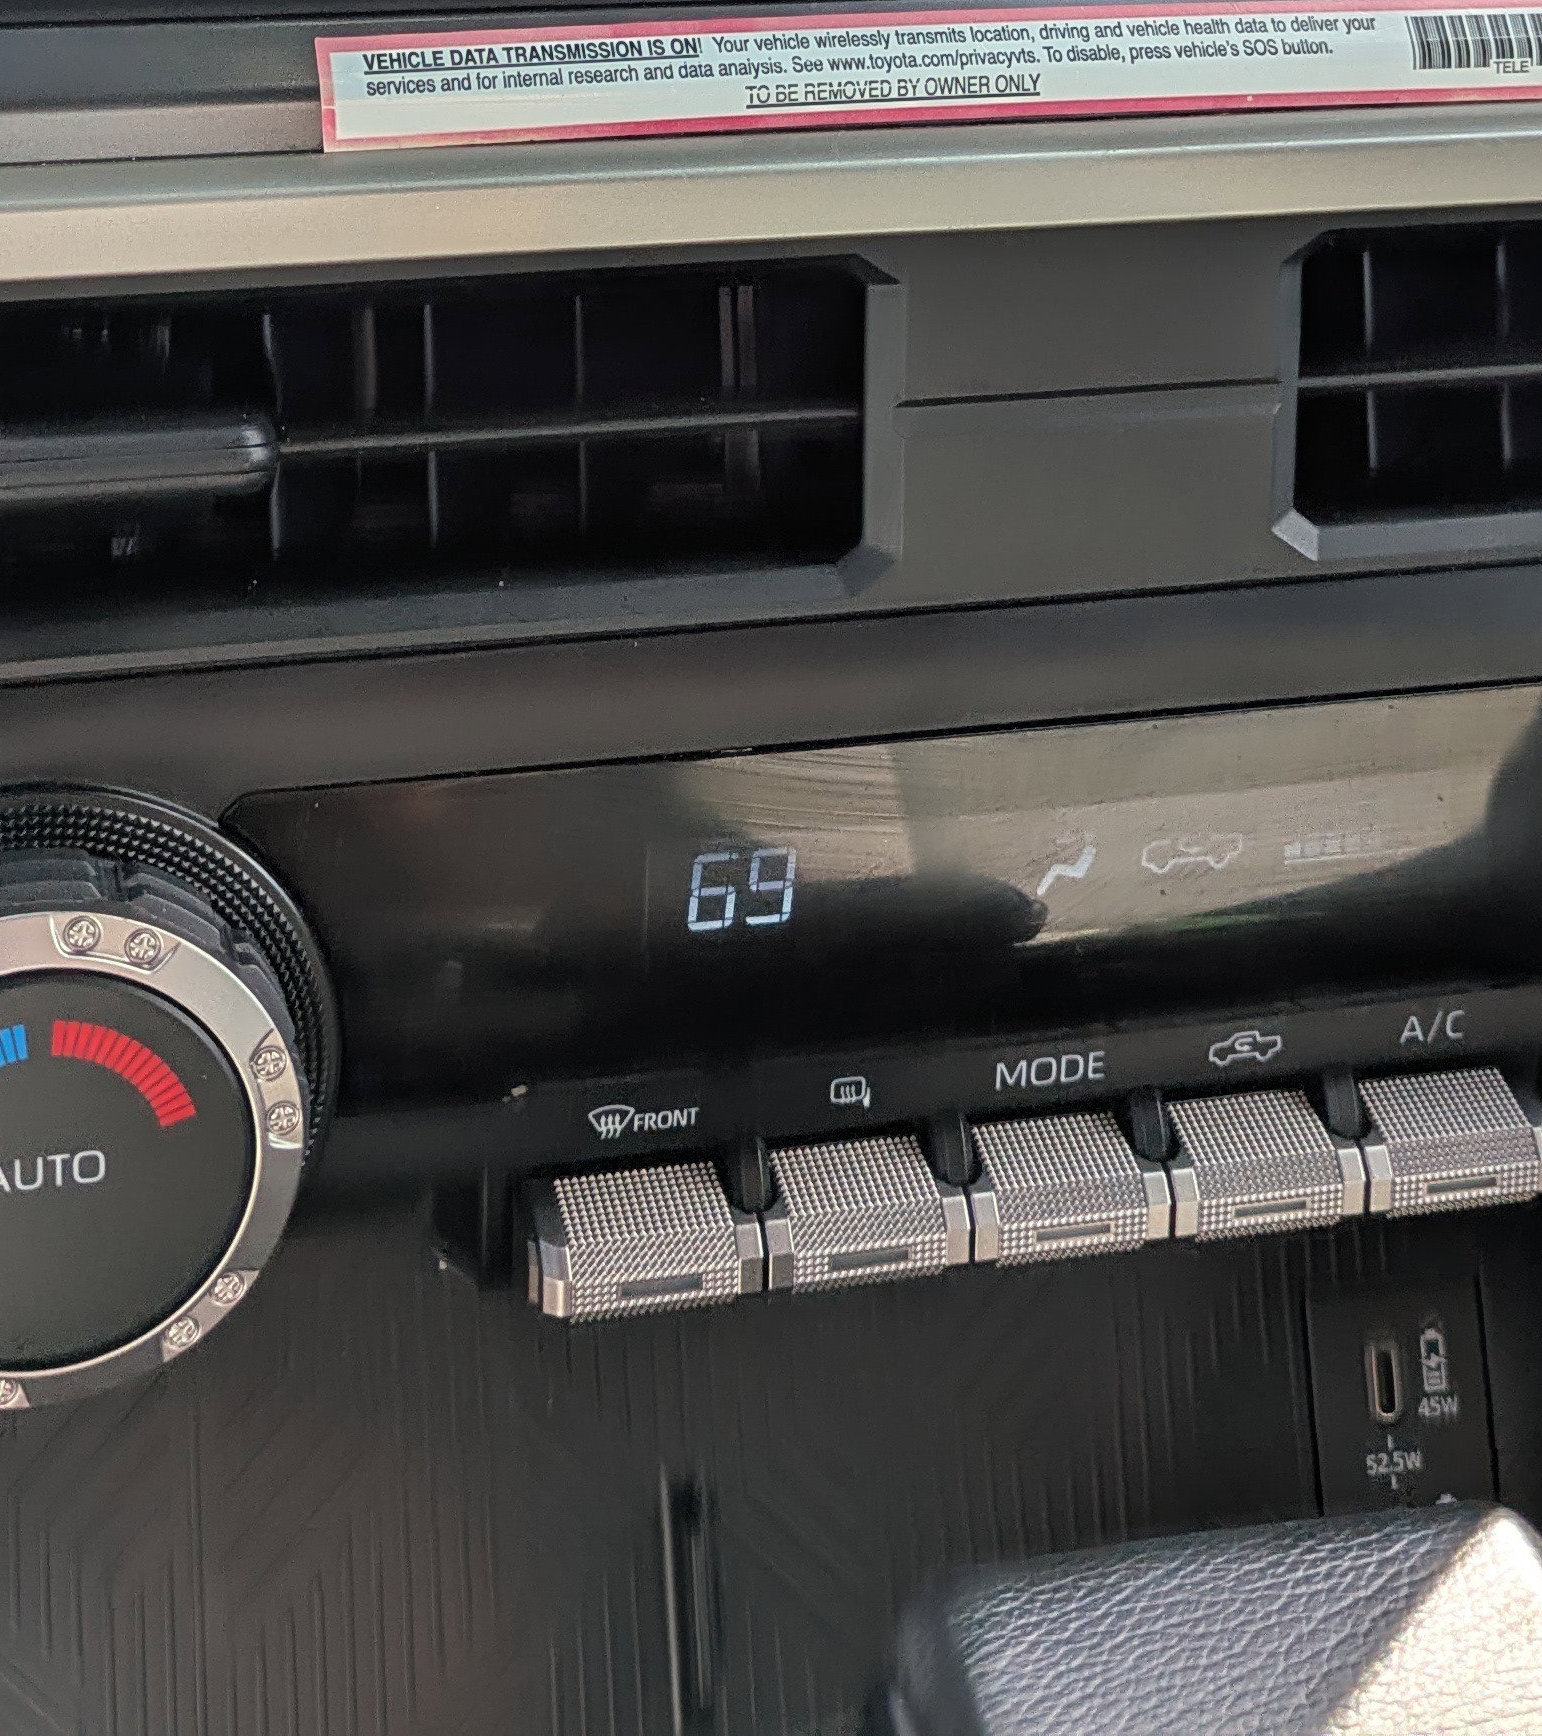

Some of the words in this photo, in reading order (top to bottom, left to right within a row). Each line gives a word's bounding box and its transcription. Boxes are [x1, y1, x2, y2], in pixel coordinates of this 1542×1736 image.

[363, 50, 445, 71] VEHICLE
[449, 48, 499, 67] DATA
[502, 40, 642, 63] TRANSMISSION
[647, 39, 665, 56] IS
[712, 36, 750, 53] Your
[753, 33, 809, 51] vehicle
[814, 29, 890, 50] wirelessly
[895, 27, 966, 46] transmits
[970, 25, 1035, 43] location,
[1039, 23, 1090, 42] driving
[1094, 21, 1123, 38] and
[1126, 19, 1180, 37] vehicle
[1183, 18, 1231, 35] health
[1235, 17, 1268, 34] data
[1271, 17, 1286, 33] to
[1290, 15, 1338, 32] deliver
[1342, 17, 1376, 35] your
[366, 76, 436, 97] services
[440, 73, 471, 92] and
[476, 72, 498, 90] for
[502, 68, 563, 88] internal
[568, 64, 639, 85] research
[643, 62, 673, 81] and
[678, 61, 714, 79] data
[791, 55, 824, 73] See
[827, 47, 1041, 74] www.toyota.com/privacyvts.
[1042, 45, 1063, 63] To
[1066, 44, 1126, 63] disable,
[1129, 45, 1172, 65] press
[1174, 40, 1239, 60] vehicle's
[1242, 38, 1278, 57] SOS
[1281, 38, 1334, 56] button.
[1493, 60, 1530, 74] TELE
[745, 84, 771, 105] TO
[775, 83, 799, 103] BE
[804, 79, 892, 102] REMOVED
[897, 77, 921, 97] BY
[924, 75, 990, 96] OWNER
[995, 73, 1041, 94] ONLY
[686, 845, 797, 933] 69
[1399, 1010, 1465, 1044] A/C
[995, 1050, 1106, 1090] MODE
[633, 1105, 699, 1132] FRONT
